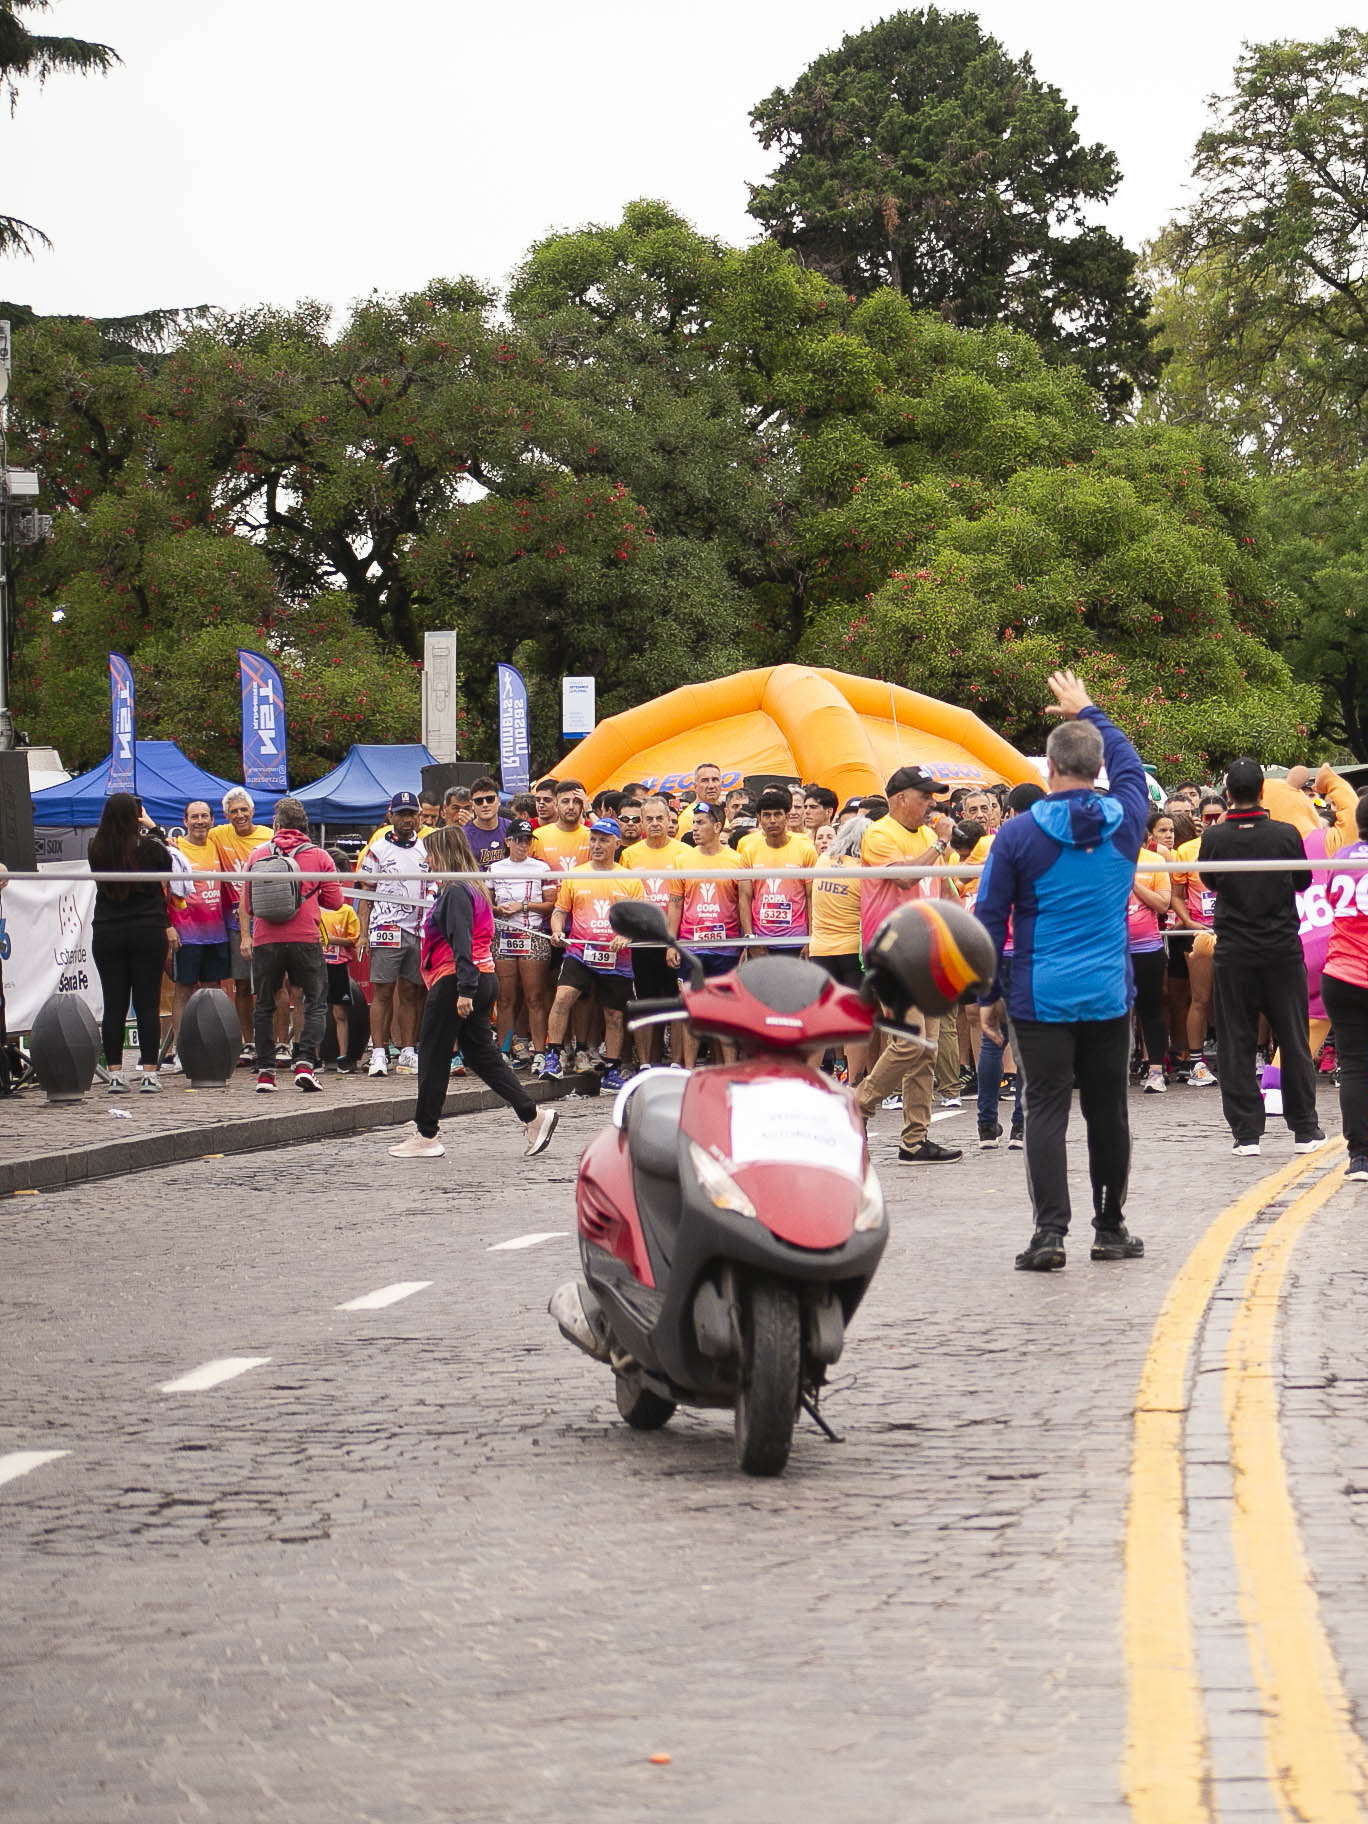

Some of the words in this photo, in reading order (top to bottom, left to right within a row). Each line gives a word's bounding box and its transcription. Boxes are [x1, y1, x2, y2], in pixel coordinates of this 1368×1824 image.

[46, 839, 63, 854] SOX
[817, 880, 849, 896] JUEZ
[696, 903, 721, 913] COPA
[764, 910, 788, 920] 5323
[376, 932, 394, 941] 903
[592, 952, 610, 962] 139
